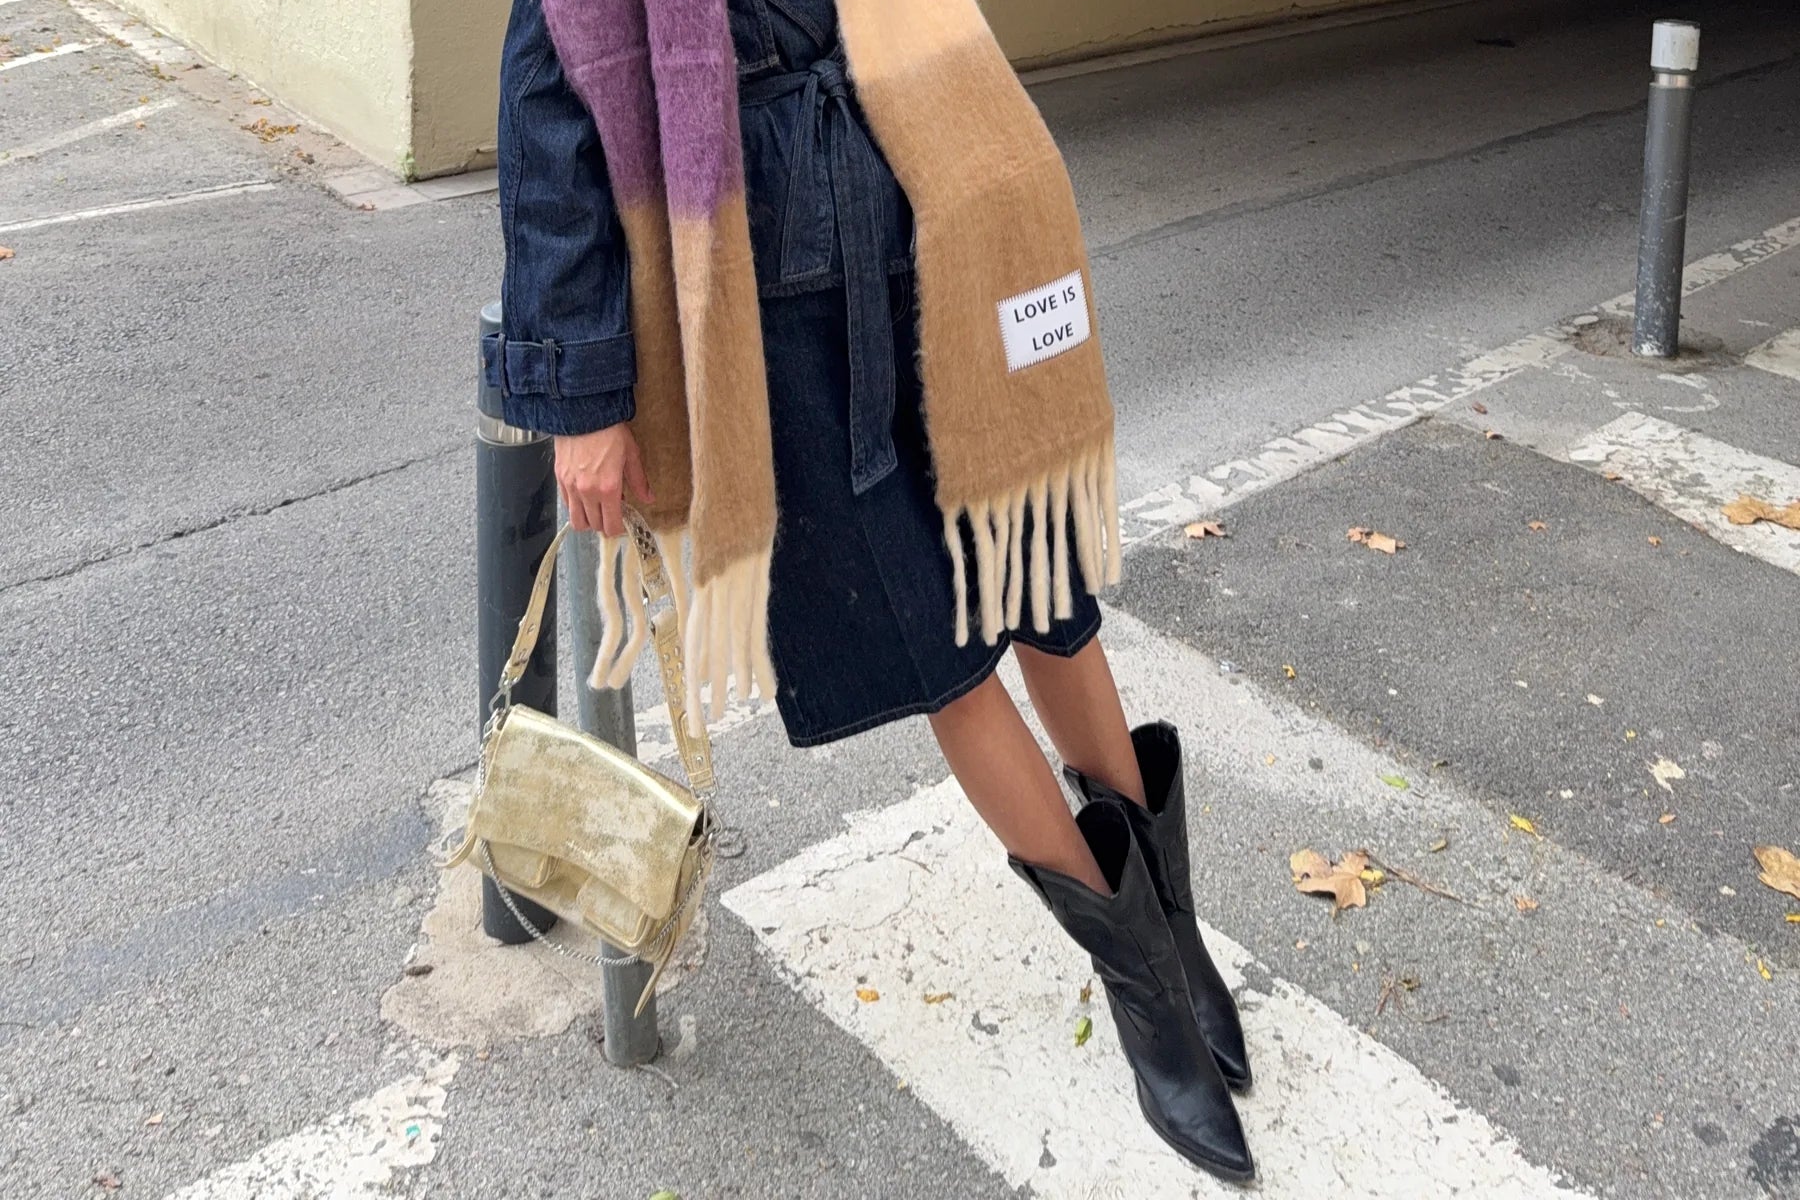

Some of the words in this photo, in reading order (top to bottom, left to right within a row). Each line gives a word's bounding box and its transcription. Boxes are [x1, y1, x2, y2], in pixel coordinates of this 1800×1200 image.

[1014, 294, 1058, 323] LOVE
[1062, 286, 1076, 304] IS
[1032, 322, 1074, 351] LOVE
